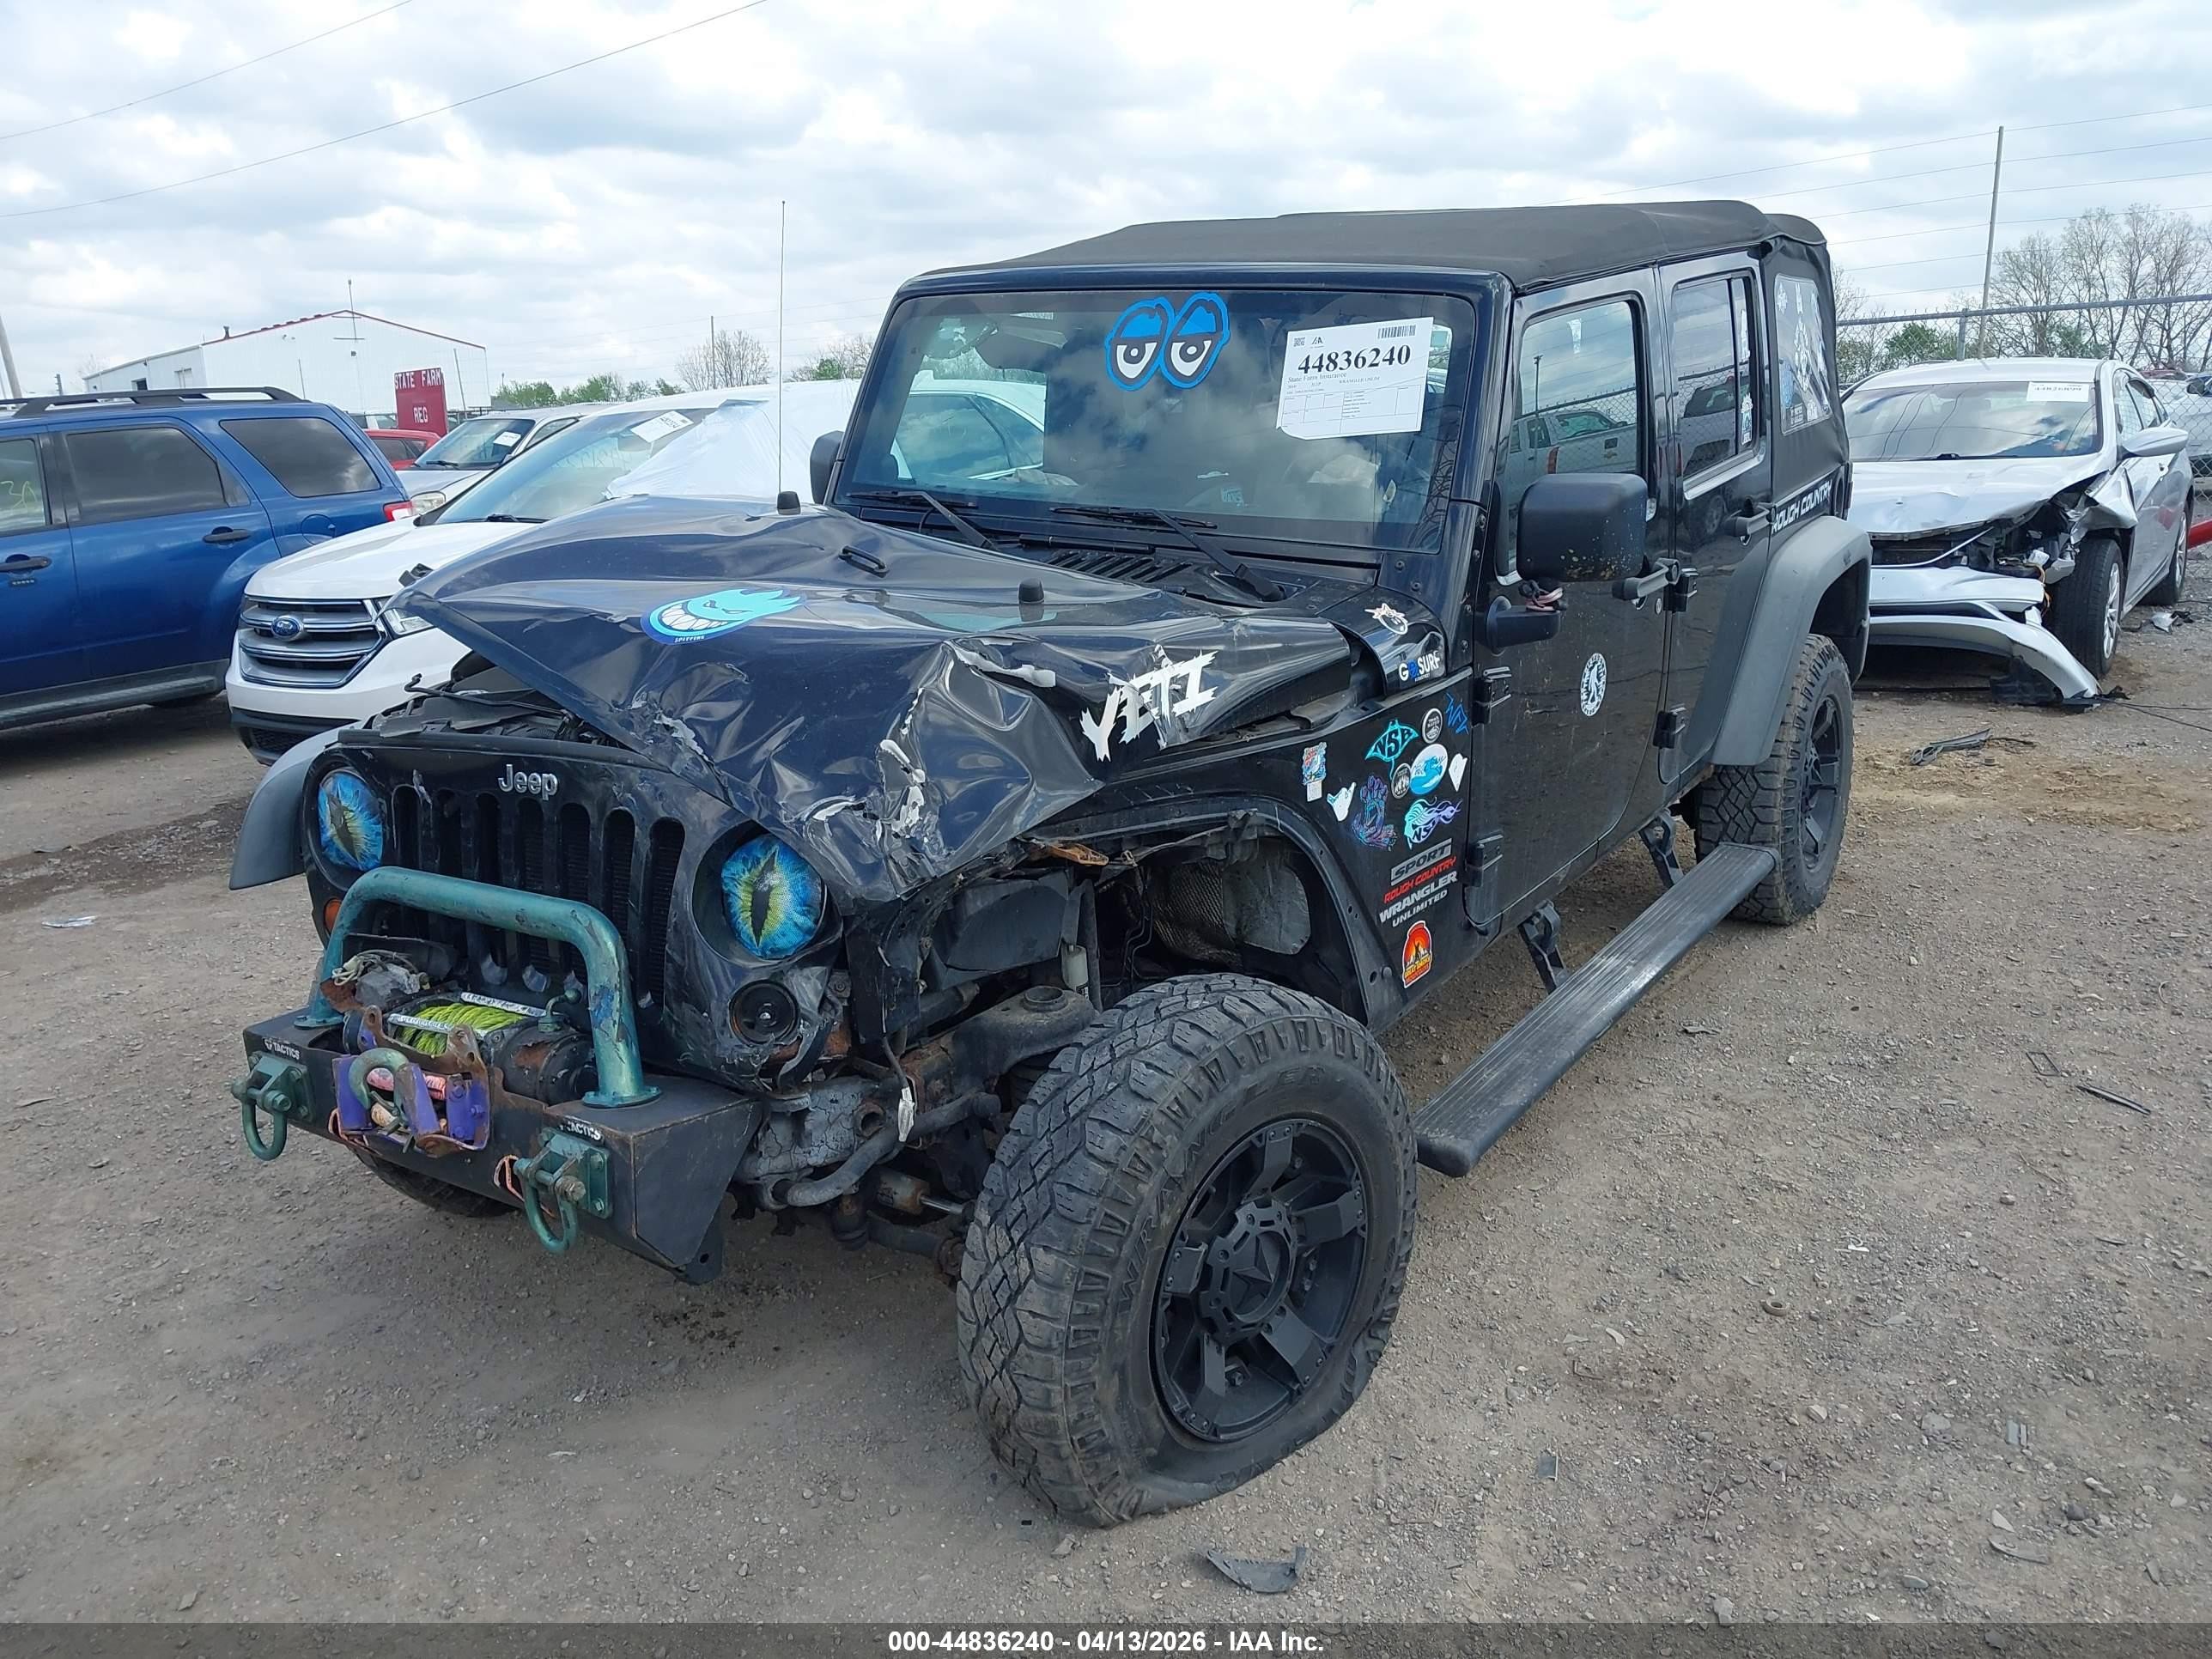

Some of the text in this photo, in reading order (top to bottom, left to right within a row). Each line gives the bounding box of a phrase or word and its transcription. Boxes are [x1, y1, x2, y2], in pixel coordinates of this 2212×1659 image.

[1297, 344, 1411, 374] 44836240
[394, 369, 441, 390] STATE FARM
[413, 406, 428, 423] REG
[1771, 479, 1832, 535] ROUGH COUNTRY
[1079, 648, 1219, 763] YETI
[498, 763, 558, 800] Jeep
[1395, 843, 1451, 878] SPORT
[1379, 871, 1457, 922] WRANGLER
[1384, 855, 1456, 904] ROUGH COUNTRY
[1392, 890, 1448, 927] UNLIMITED
[272, 1042, 300, 1060] TACTICS
